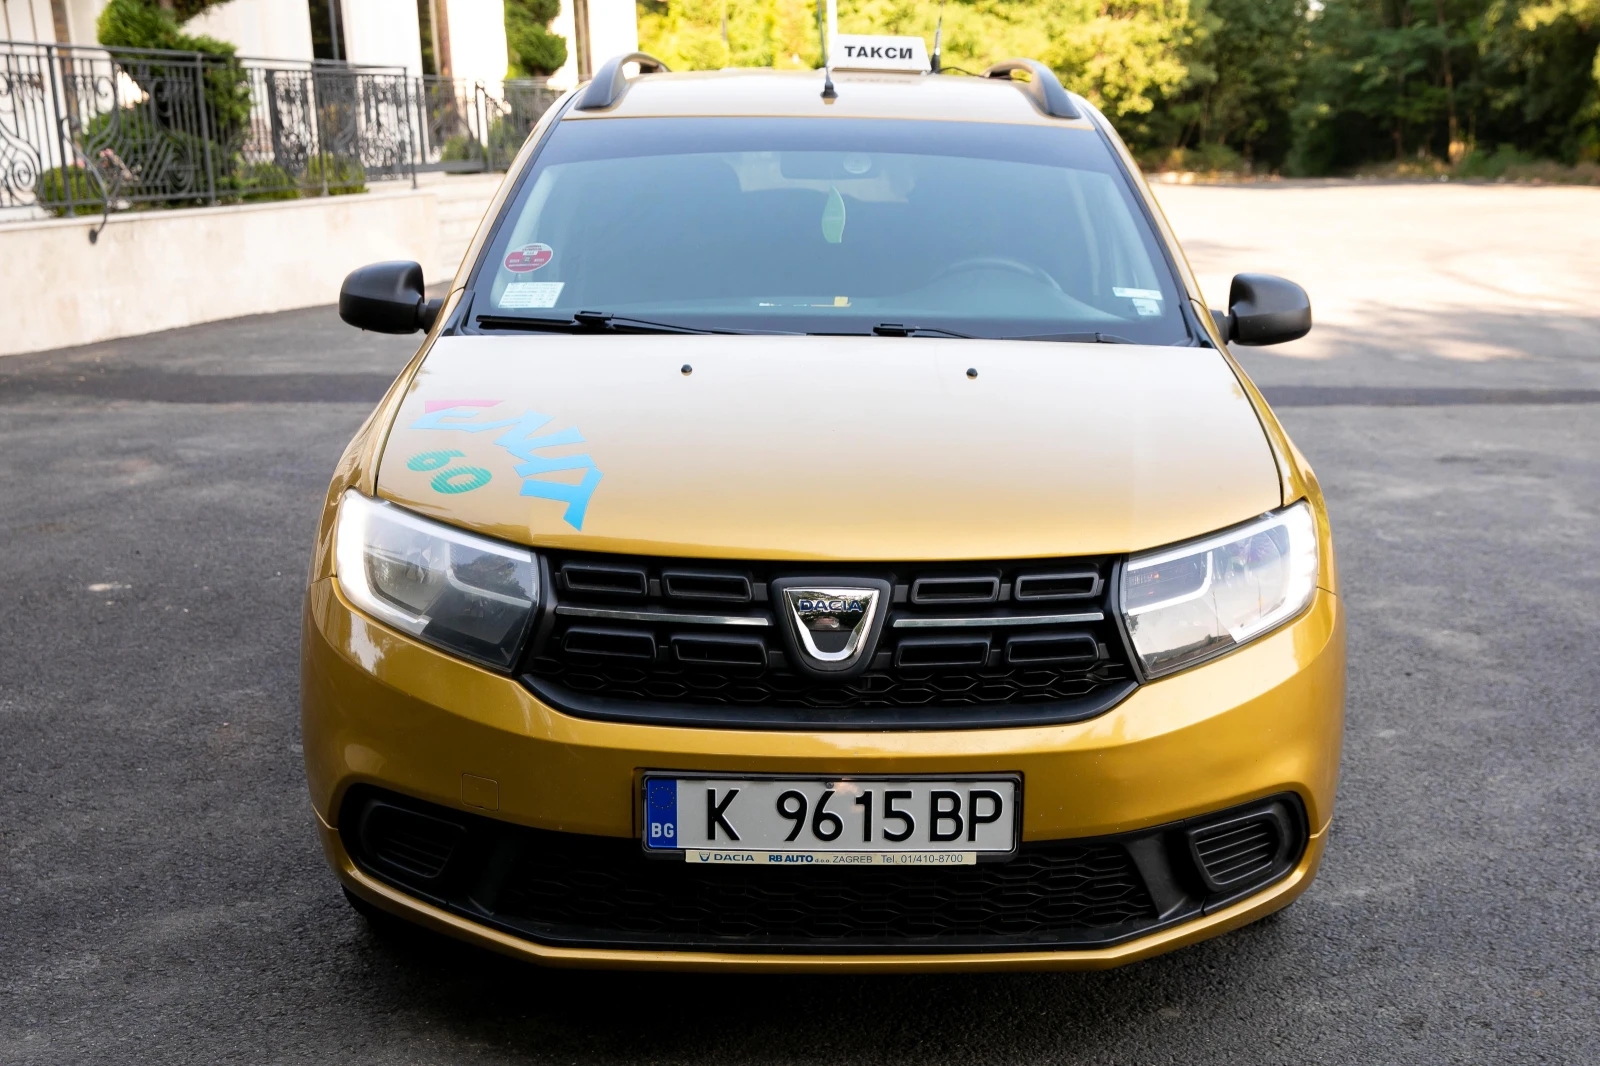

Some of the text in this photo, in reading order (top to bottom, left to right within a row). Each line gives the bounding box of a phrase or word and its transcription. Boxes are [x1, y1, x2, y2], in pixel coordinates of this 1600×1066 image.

[844, 46, 913, 59] ТАКСИ
[406, 449, 492, 495] 60
[799, 599, 863, 612] DACIA
[707, 788, 741, 841] K
[651, 823, 674, 838] BG
[714, 853, 755, 862] DACIA
[768, 854, 783, 863] RB
[784, 855, 814, 863] AUTO
[832, 855, 873, 864] ZAGREB
[881, 854, 898, 864] Tel.
[900, 854, 964, 864] 01/410-8700
